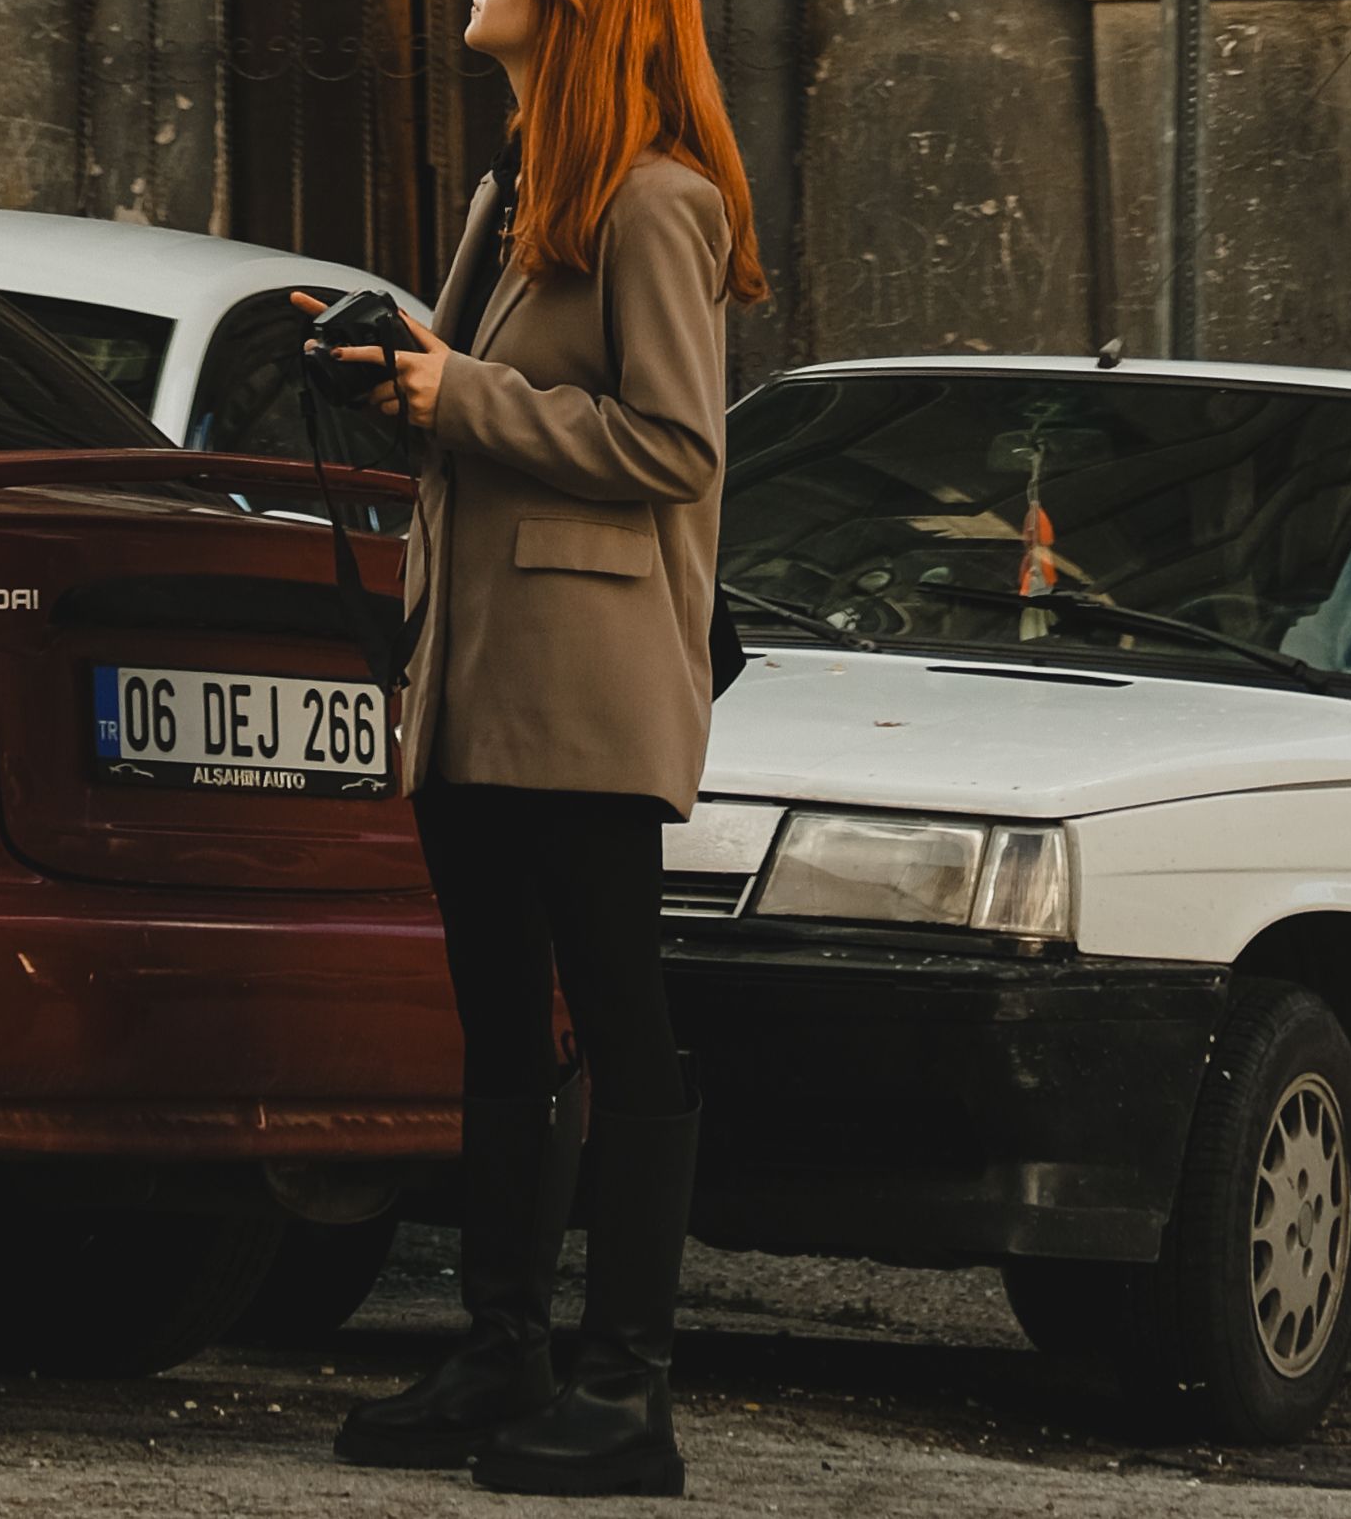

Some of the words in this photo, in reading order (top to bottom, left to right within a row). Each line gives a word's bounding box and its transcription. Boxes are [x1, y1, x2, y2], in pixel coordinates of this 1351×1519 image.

[98, 720, 118, 742] TR
[124, 676, 176, 753] 06
[202, 682, 279, 759] DEJ
[303, 688, 375, 765] 266
[262, 770, 306, 790] AUTO
